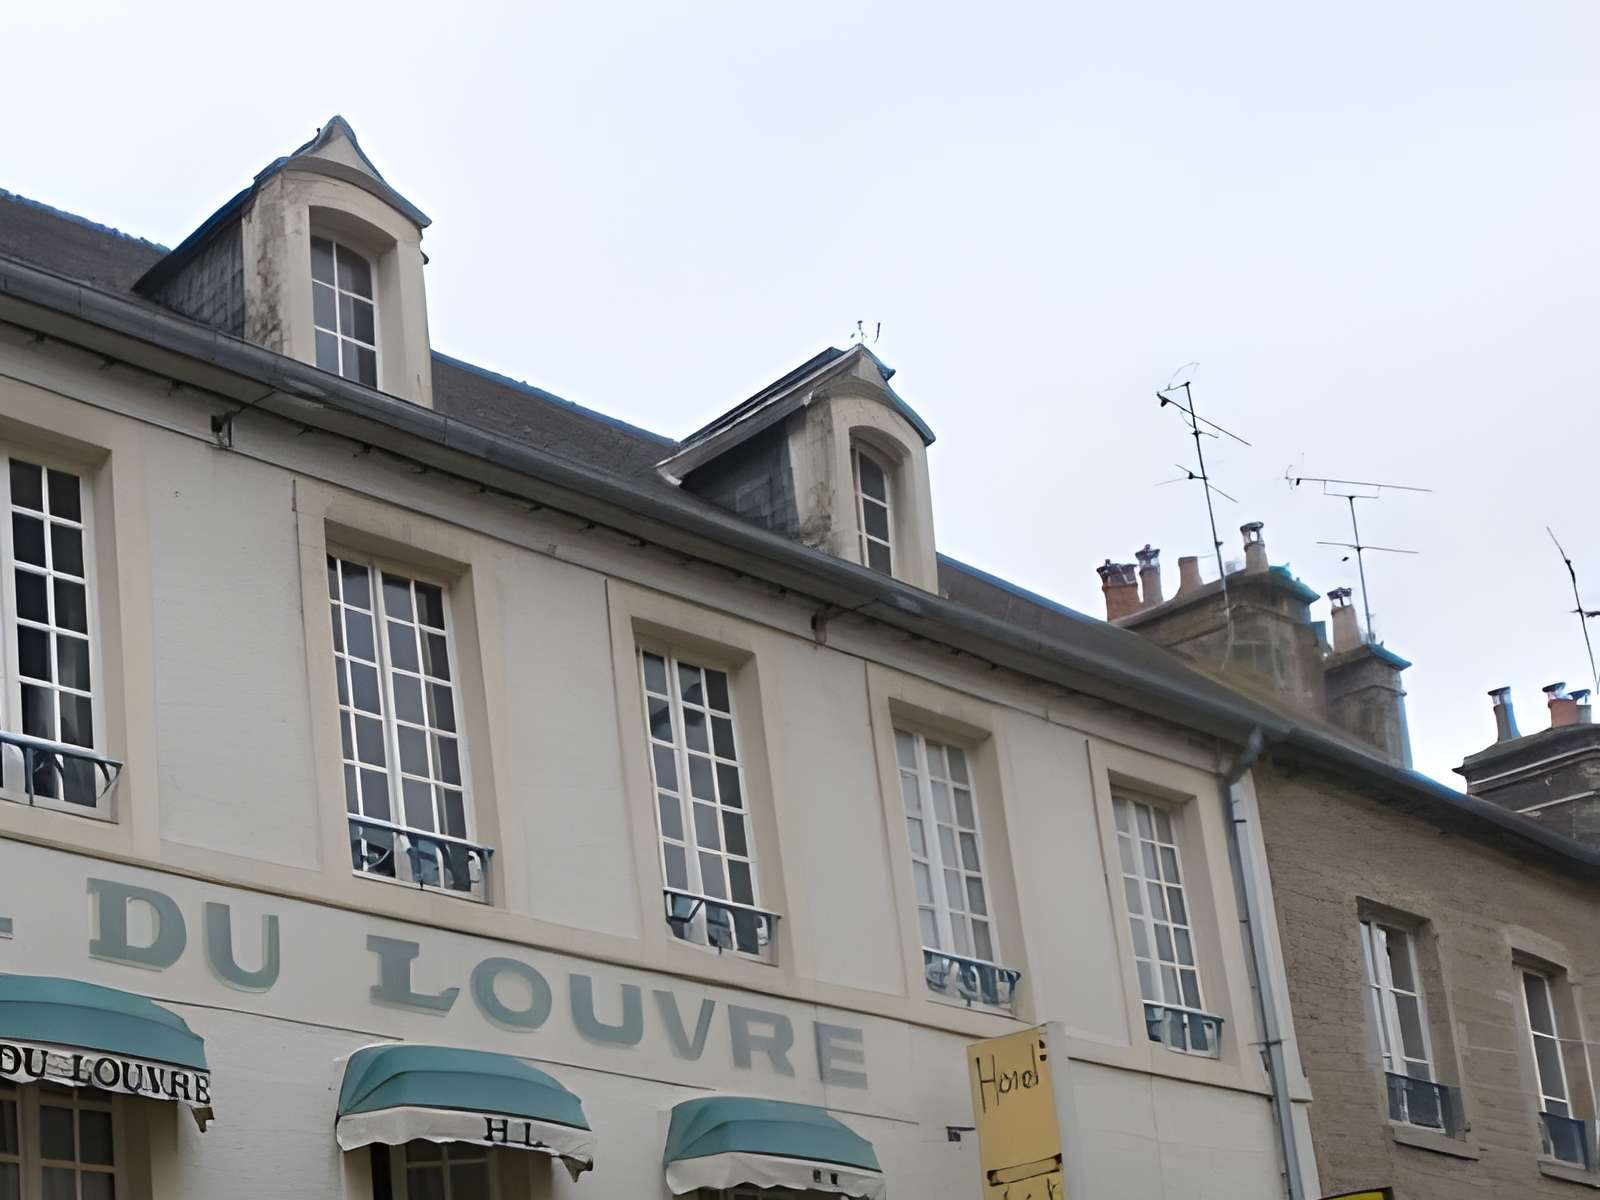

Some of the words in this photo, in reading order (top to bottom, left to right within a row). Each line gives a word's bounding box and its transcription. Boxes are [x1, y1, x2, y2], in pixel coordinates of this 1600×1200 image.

[86, 877, 281, 994] DU
[366, 933, 870, 1089] LOUVRE
[71, 1054, 211, 1105] LOUVRE
